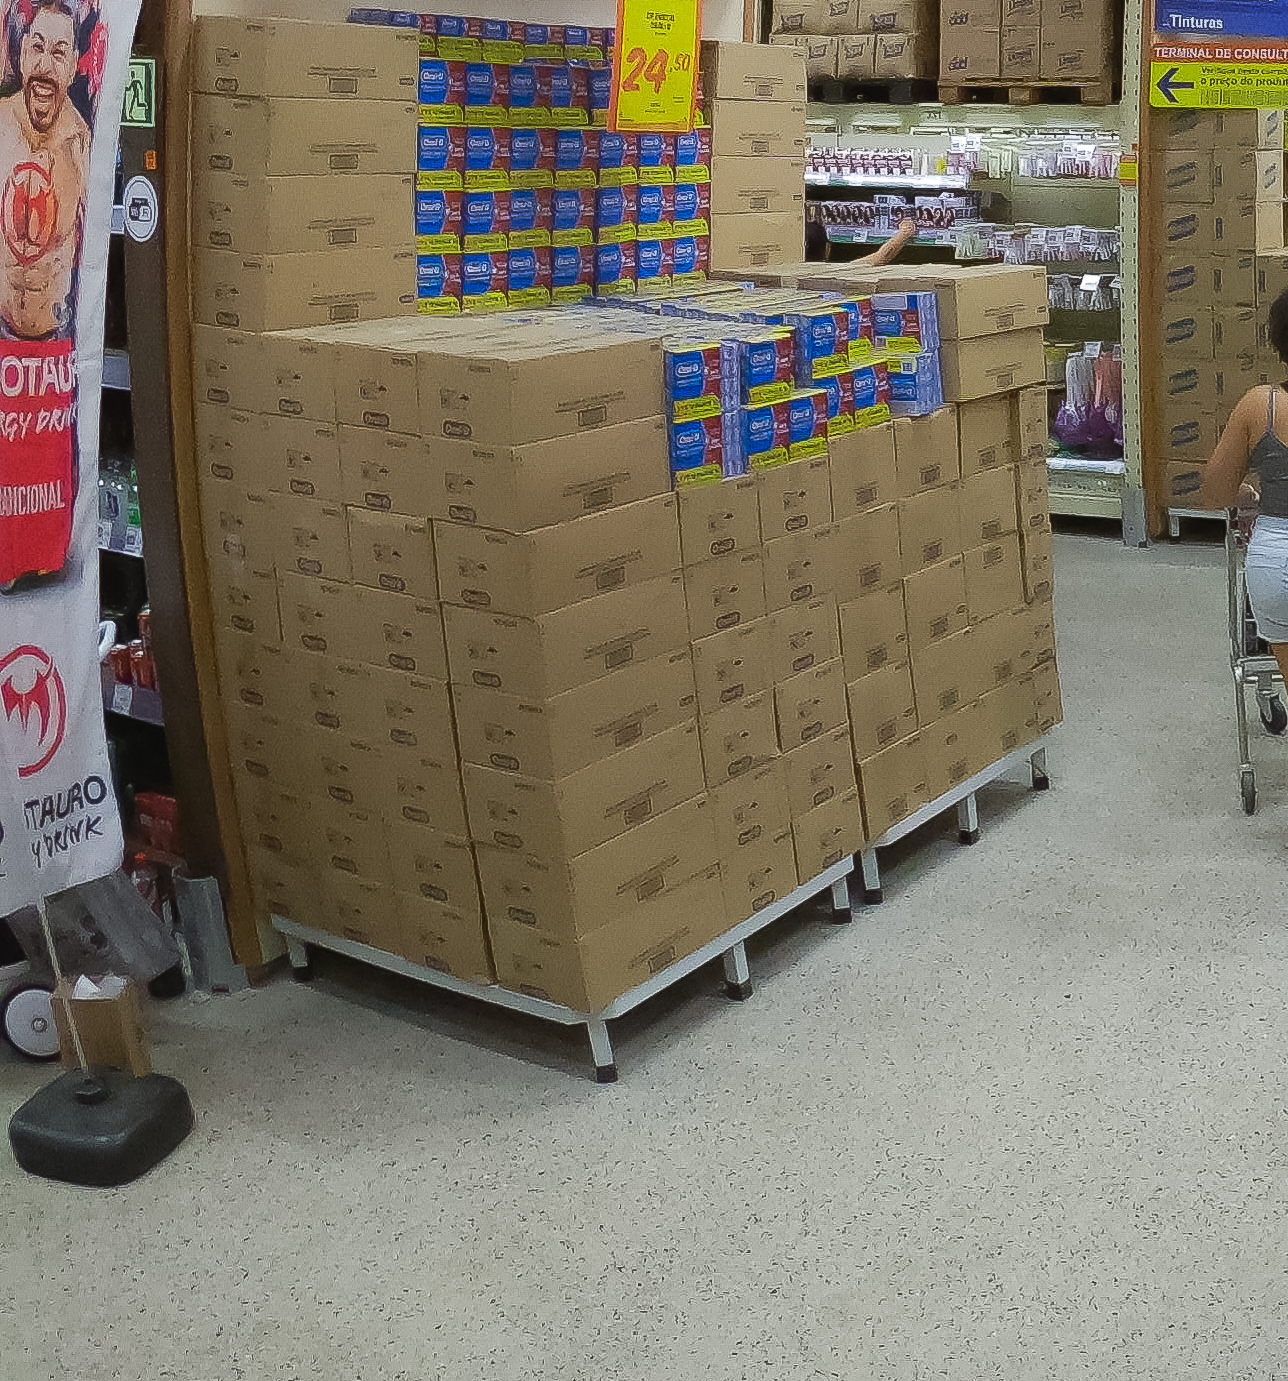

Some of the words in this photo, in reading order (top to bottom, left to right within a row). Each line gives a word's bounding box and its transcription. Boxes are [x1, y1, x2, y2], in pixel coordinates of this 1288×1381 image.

[1169, 14, 1224, 30] Tinturas
[1154, 47, 1213, 59] TERMINAL
[1215, 48, 1232, 59] DE
